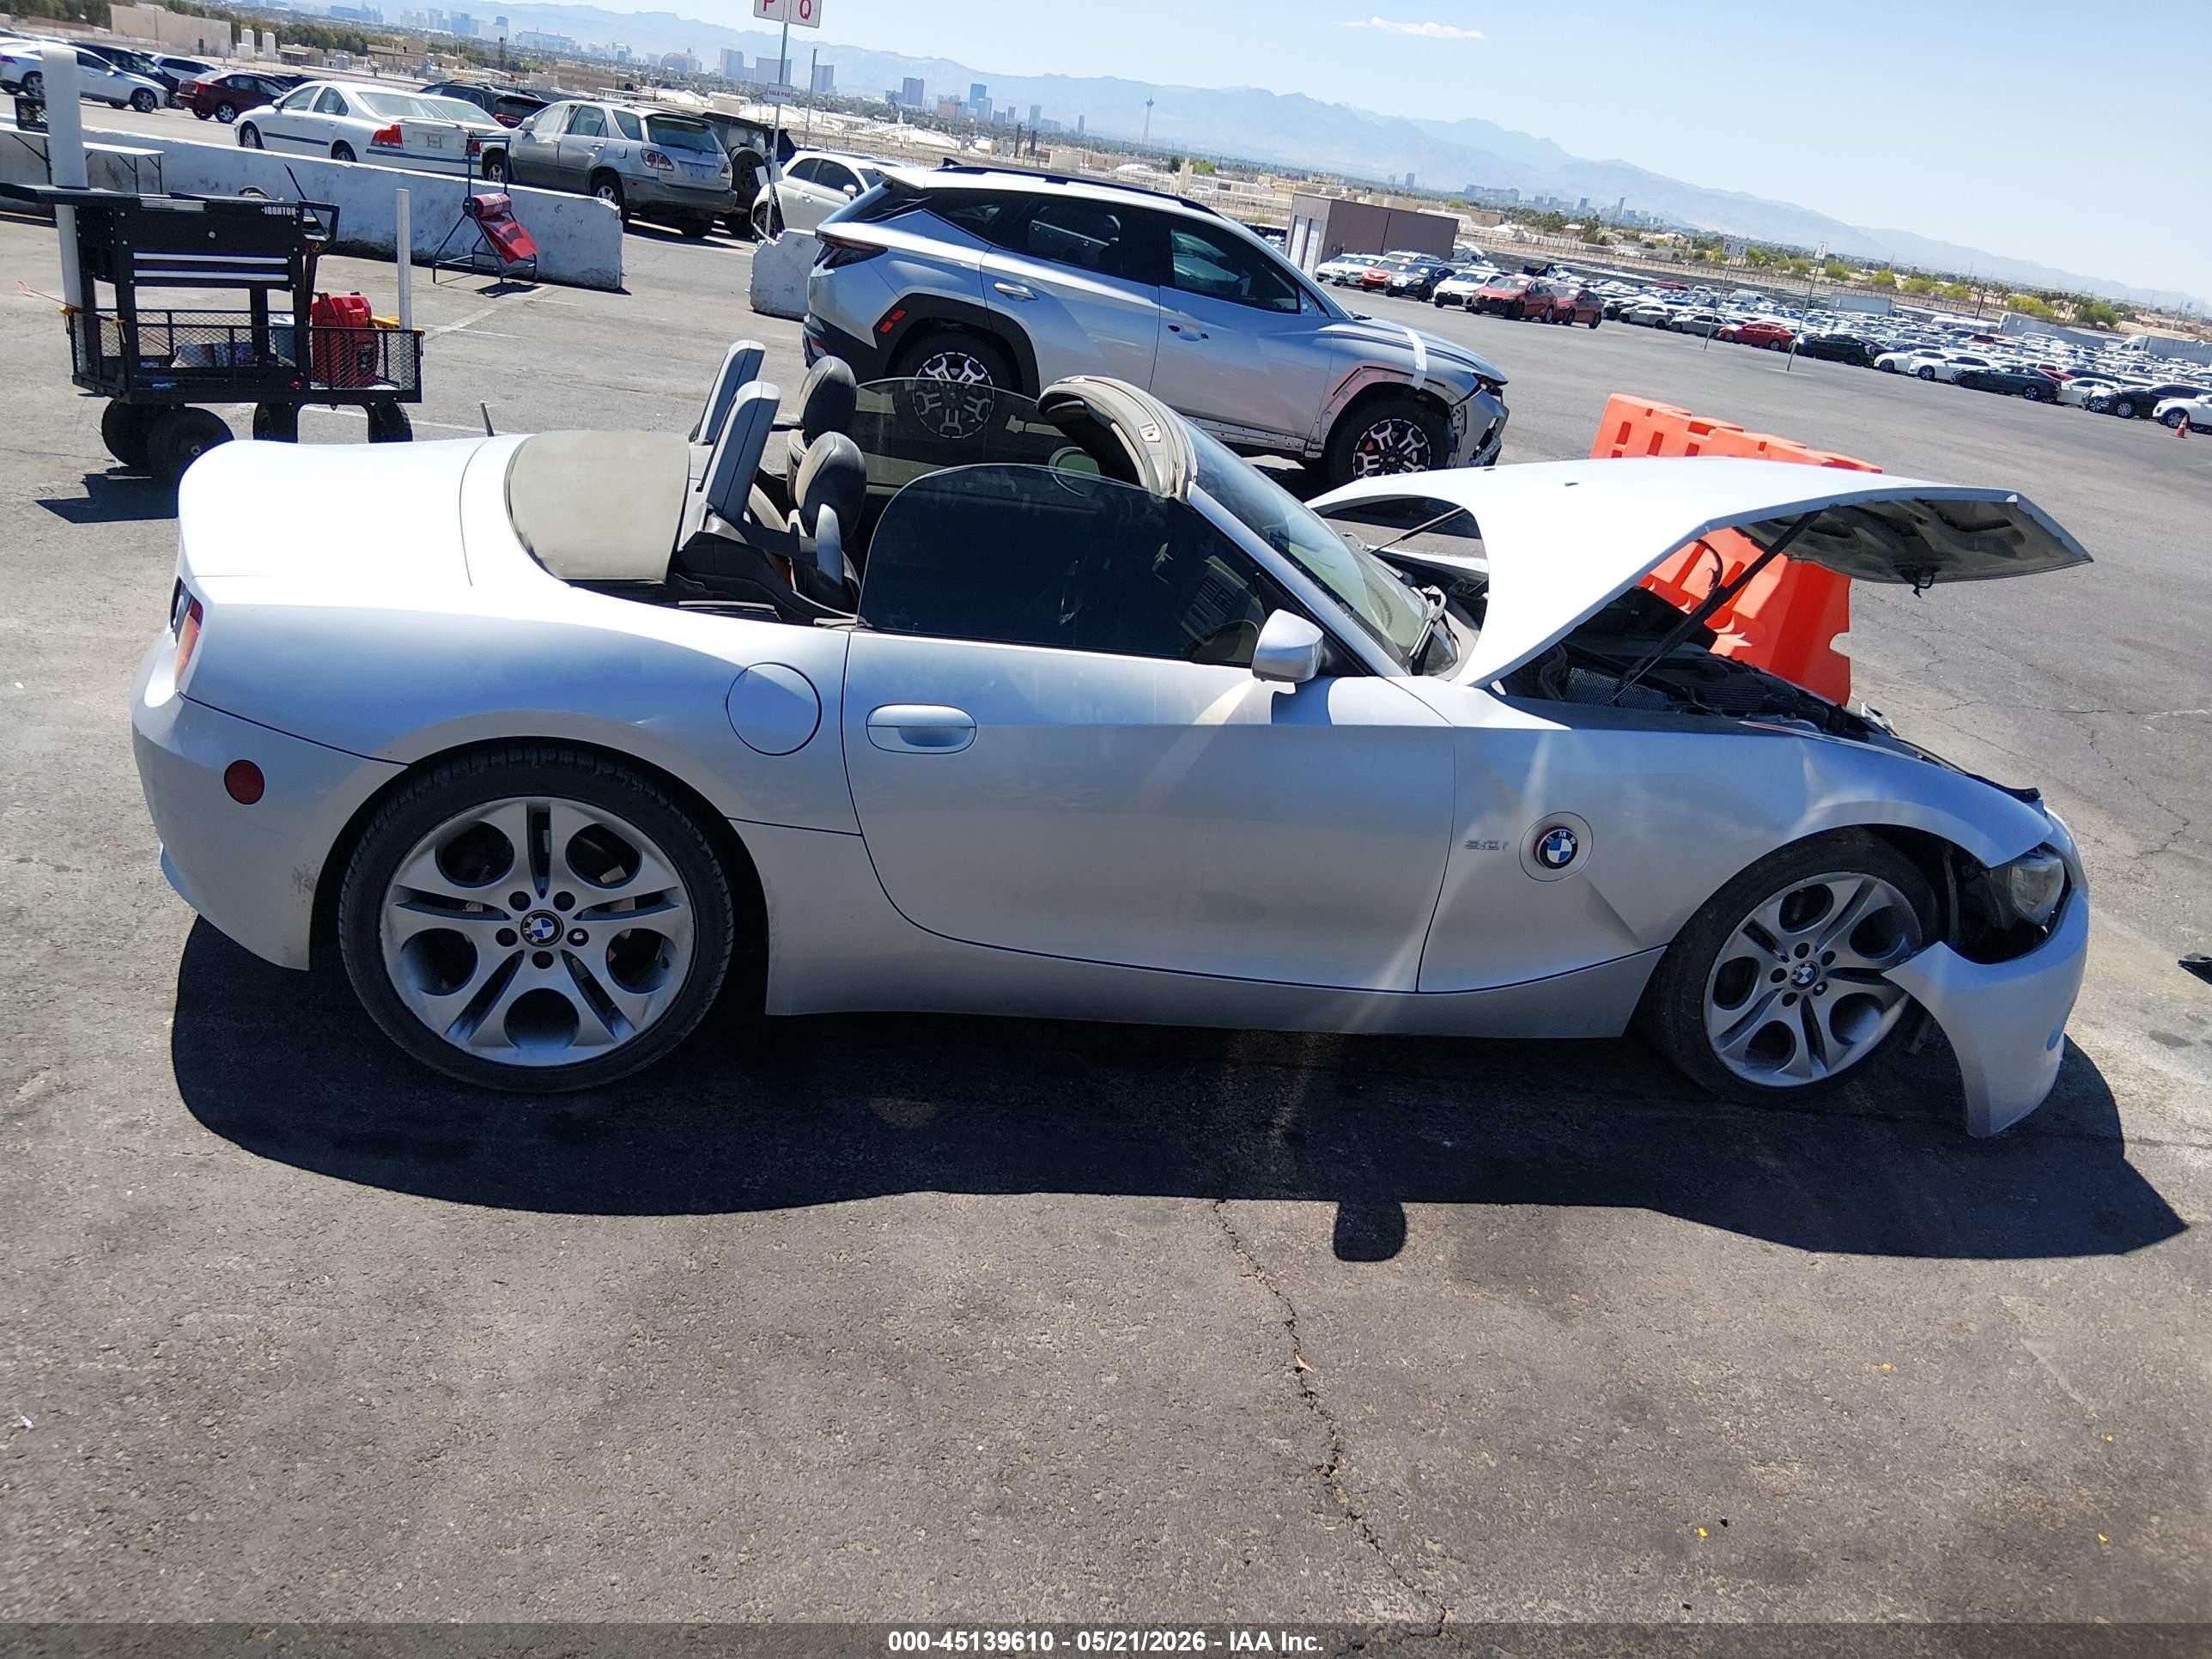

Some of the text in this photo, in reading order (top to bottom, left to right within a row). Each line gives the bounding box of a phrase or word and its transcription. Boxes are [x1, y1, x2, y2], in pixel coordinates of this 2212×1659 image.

[799, 0, 812, 20] Q
[264, 206, 296, 216] IRONTON
[1724, 243, 1731, 252] R
[1737, 246, 1745, 256] S
[1546, 830, 1577, 846] BMW
